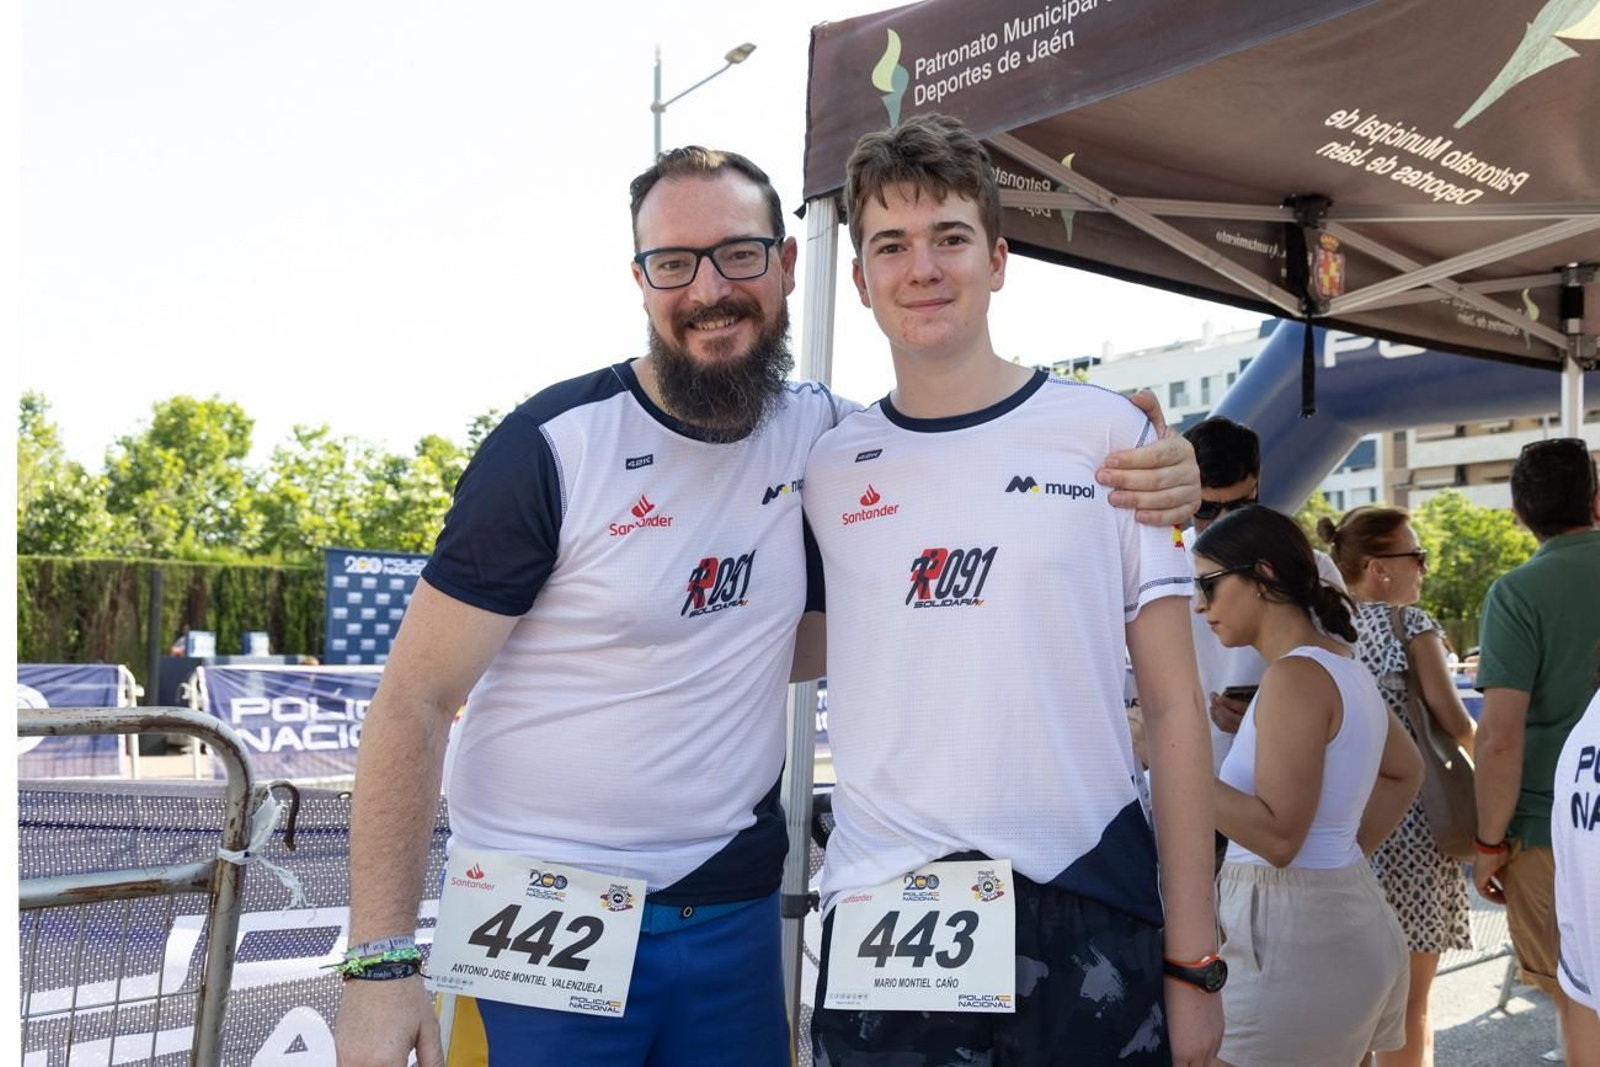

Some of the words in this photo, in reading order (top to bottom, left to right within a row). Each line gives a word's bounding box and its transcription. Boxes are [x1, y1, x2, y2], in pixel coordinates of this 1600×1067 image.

[914, 33, 998, 80] Patronato
[914, 62, 992, 106] Deportes
[997, 51, 1021, 75] de
[1026, 29, 1075, 64] Jaén
[1045, 482, 1094, 500] mupol
[842, 503, 899, 525] Santander
[451, 877, 495, 891] Santander
[467, 903, 605, 971] 442
[857, 910, 979, 969] 443
[451, 963, 488, 977] ANTONIO
[489, 969, 509, 980] JOSE
[512, 973, 547, 986] MONTIEL
[551, 978, 603, 994] VALENZUELA
[874, 977, 897, 988] MARIO
[898, 977, 931, 988] MONTIEL
[935, 976, 959, 988] CAÑO
[569, 1001, 620, 1013] NACIONAL
[570, 995, 611, 1006] POLICIA
[958, 1001, 1011, 1009] NACIONAL
